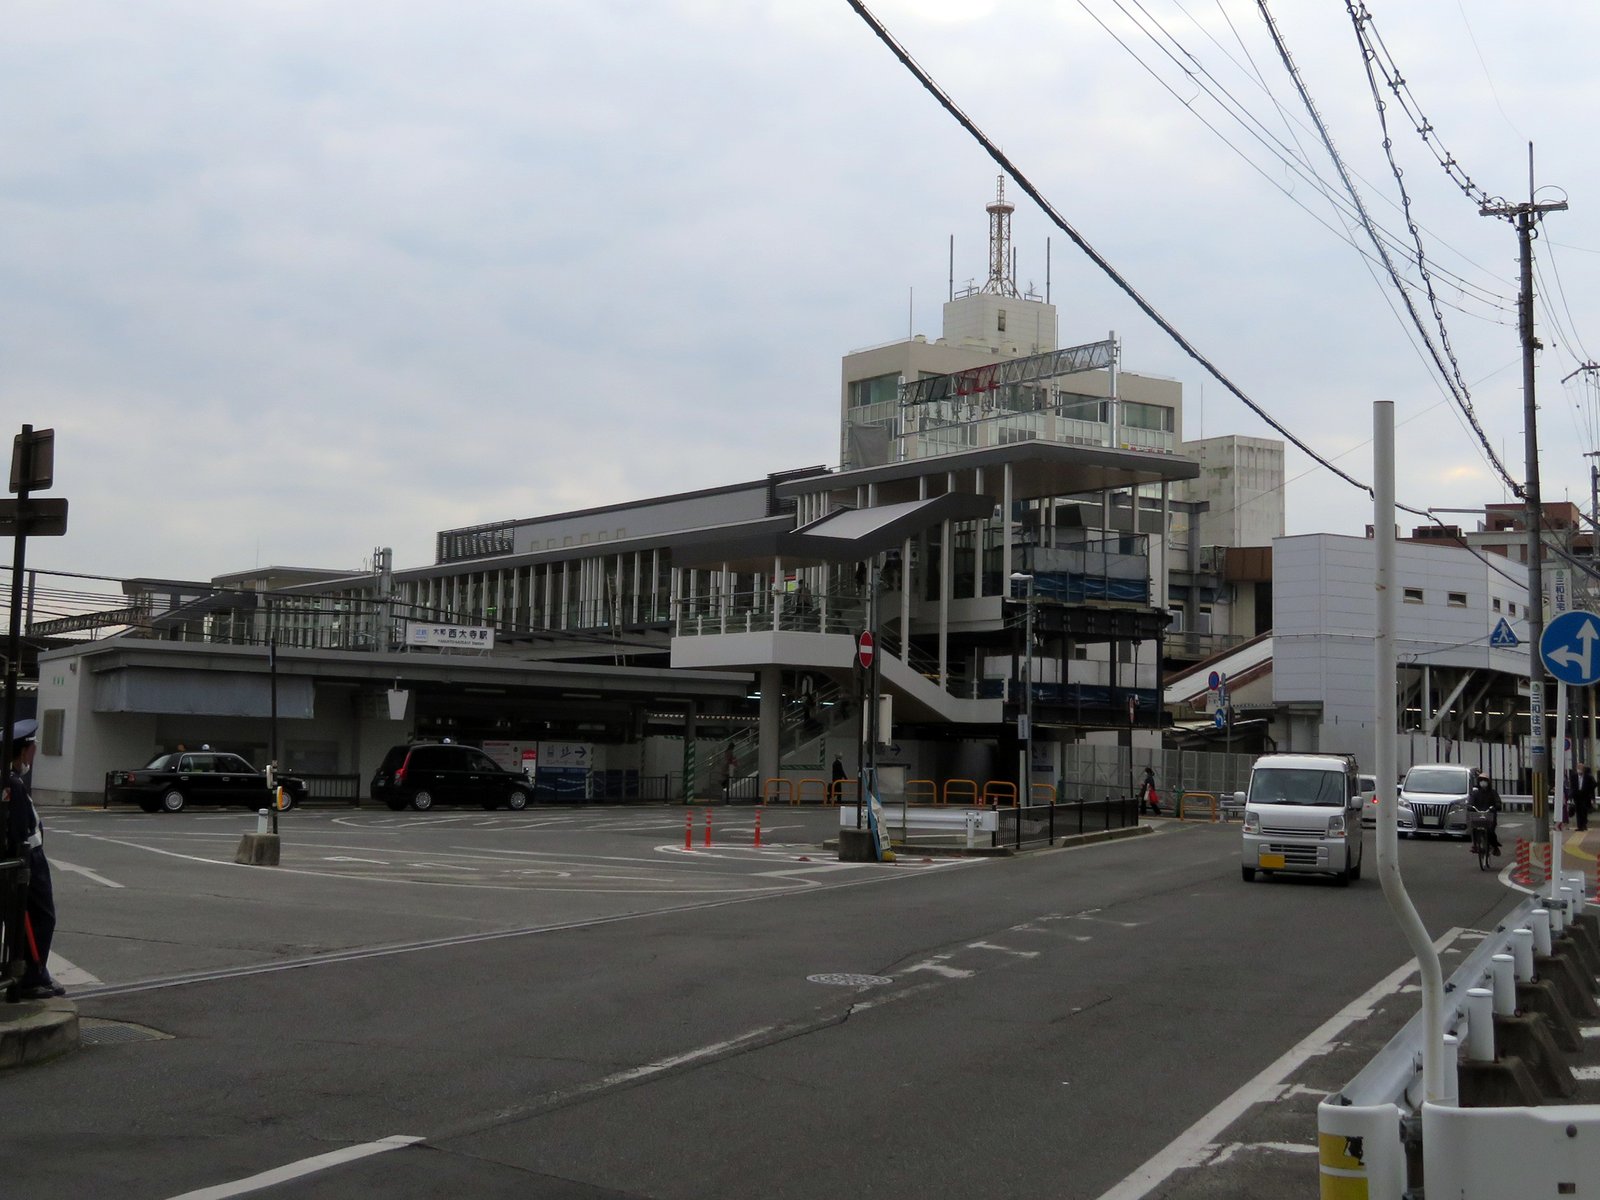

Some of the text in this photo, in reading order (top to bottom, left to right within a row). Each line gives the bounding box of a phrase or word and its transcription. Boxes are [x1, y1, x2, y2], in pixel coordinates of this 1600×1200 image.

[1555, 577, 1566, 611] 三和住宅
[1532, 693, 1542, 736] 三和住宅
